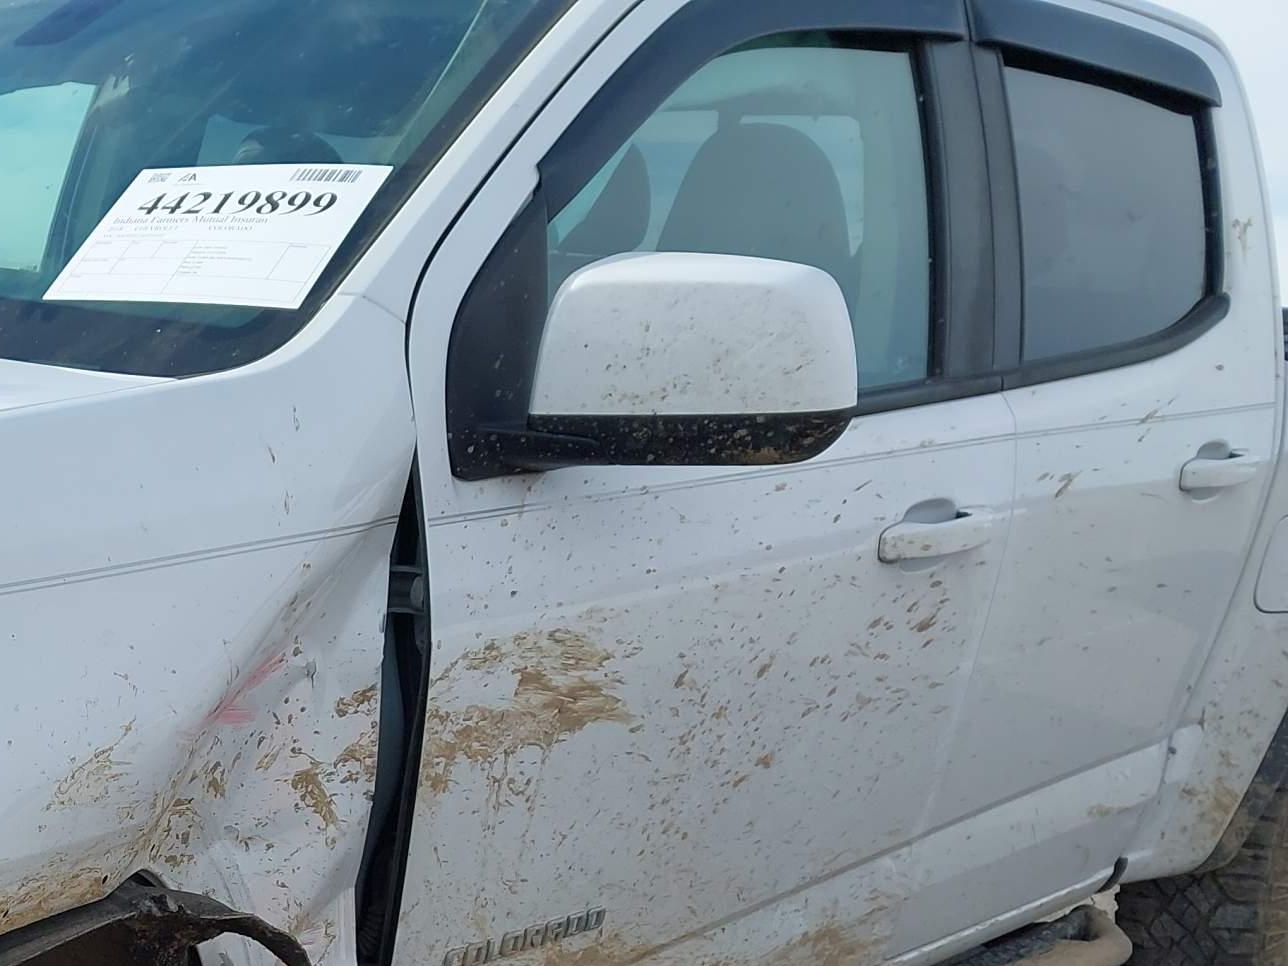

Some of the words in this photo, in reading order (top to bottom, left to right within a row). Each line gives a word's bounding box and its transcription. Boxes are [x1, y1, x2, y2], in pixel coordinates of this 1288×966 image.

[137, 190, 337, 216] 44219899
[150, 216, 189, 224] Farmers
[192, 215, 228, 224] Mutual
